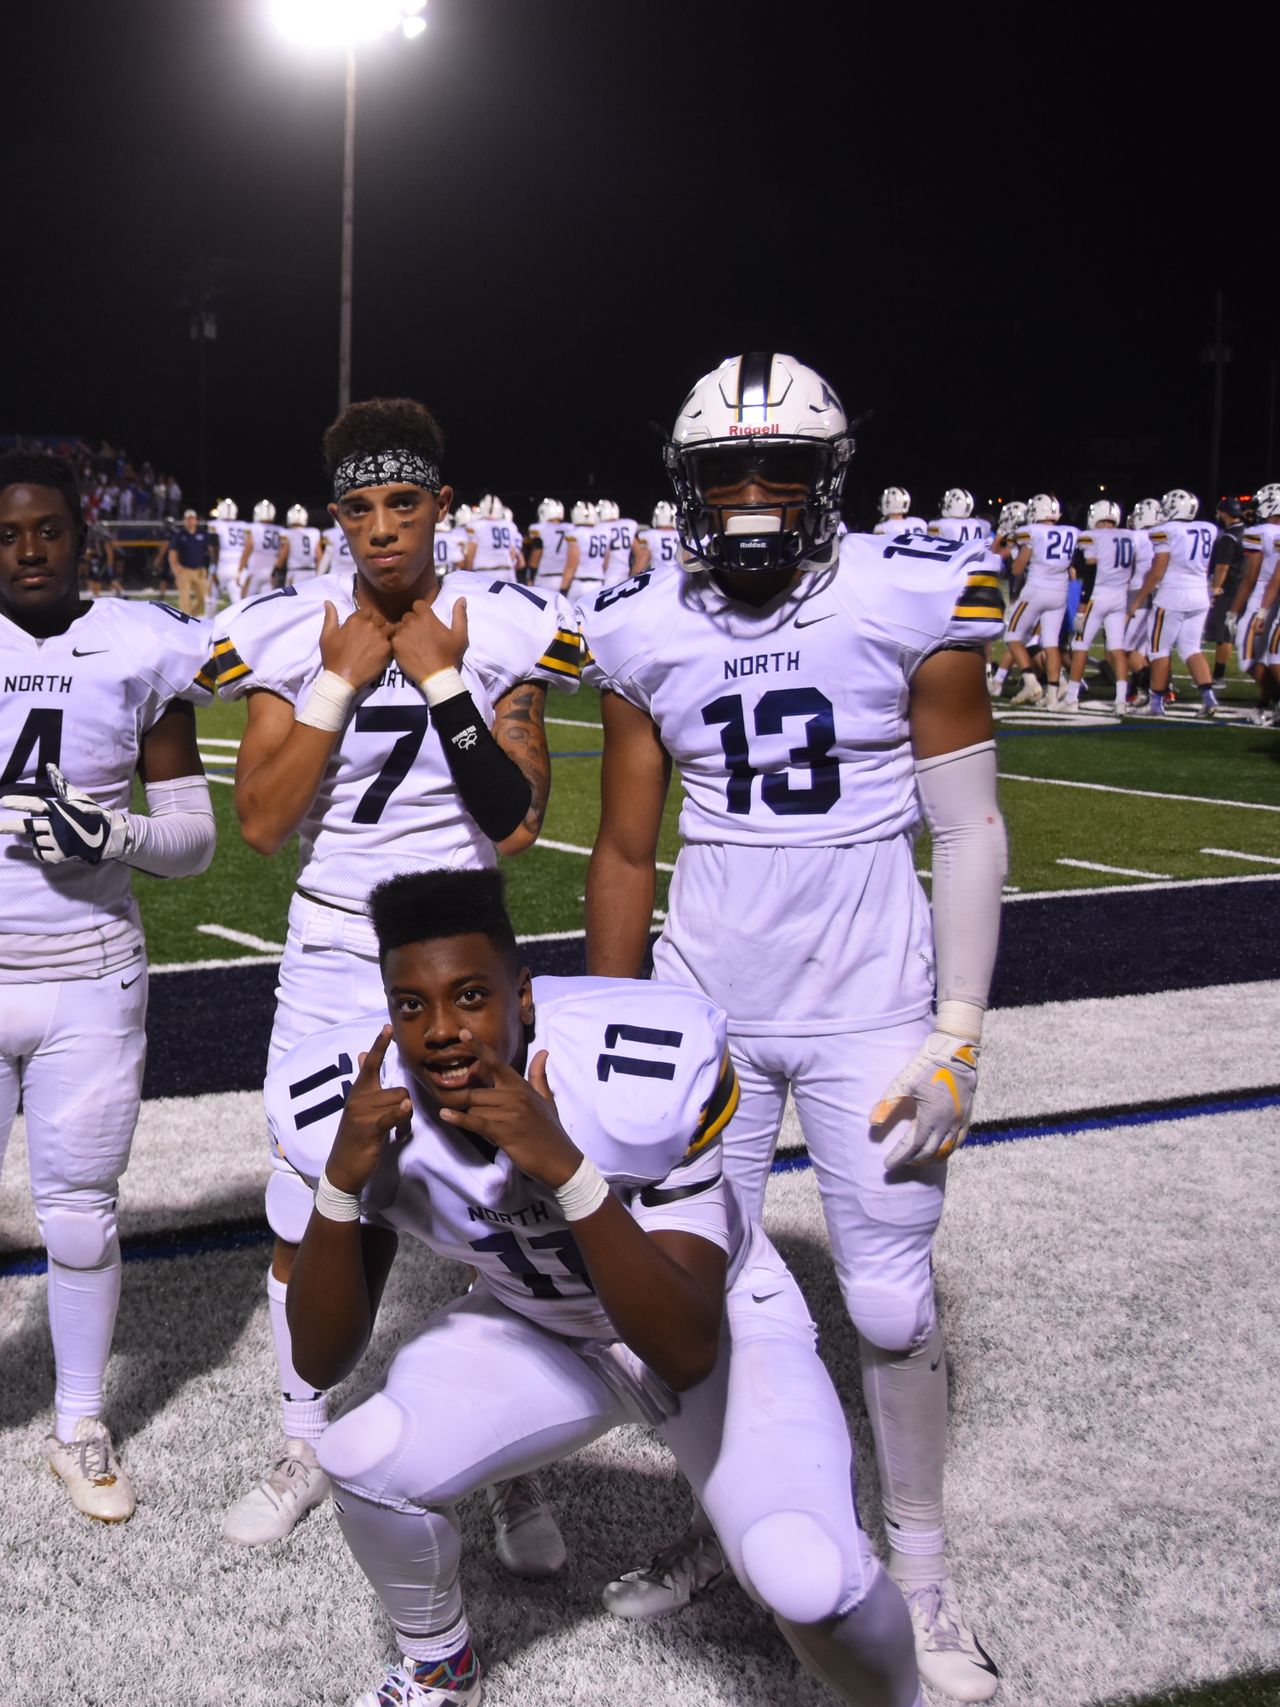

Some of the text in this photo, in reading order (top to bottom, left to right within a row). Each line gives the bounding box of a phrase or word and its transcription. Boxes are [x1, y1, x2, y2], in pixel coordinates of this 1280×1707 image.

[302, 536, 310, 555] 9
[491, 526, 510, 549] 99
[555, 530, 566, 553] 7
[588, 535, 607, 558] 66
[609, 527, 631, 550] 26
[740, 541, 767, 549] Riddell
[1046, 530, 1073, 560] 24
[1187, 528, 1212, 561] 78
[1113, 537, 1133, 568] 10
[489, 581, 548, 610] 7
[724, 651, 800, 680] NORTH
[4, 675, 73, 694] NORTH
[351, 705, 428, 824] 7
[701, 686, 841, 816] 13
[597, 1024, 684, 1082] 11
[289, 1052, 353, 1131] 11
[467, 1200, 550, 1227] NORTH
